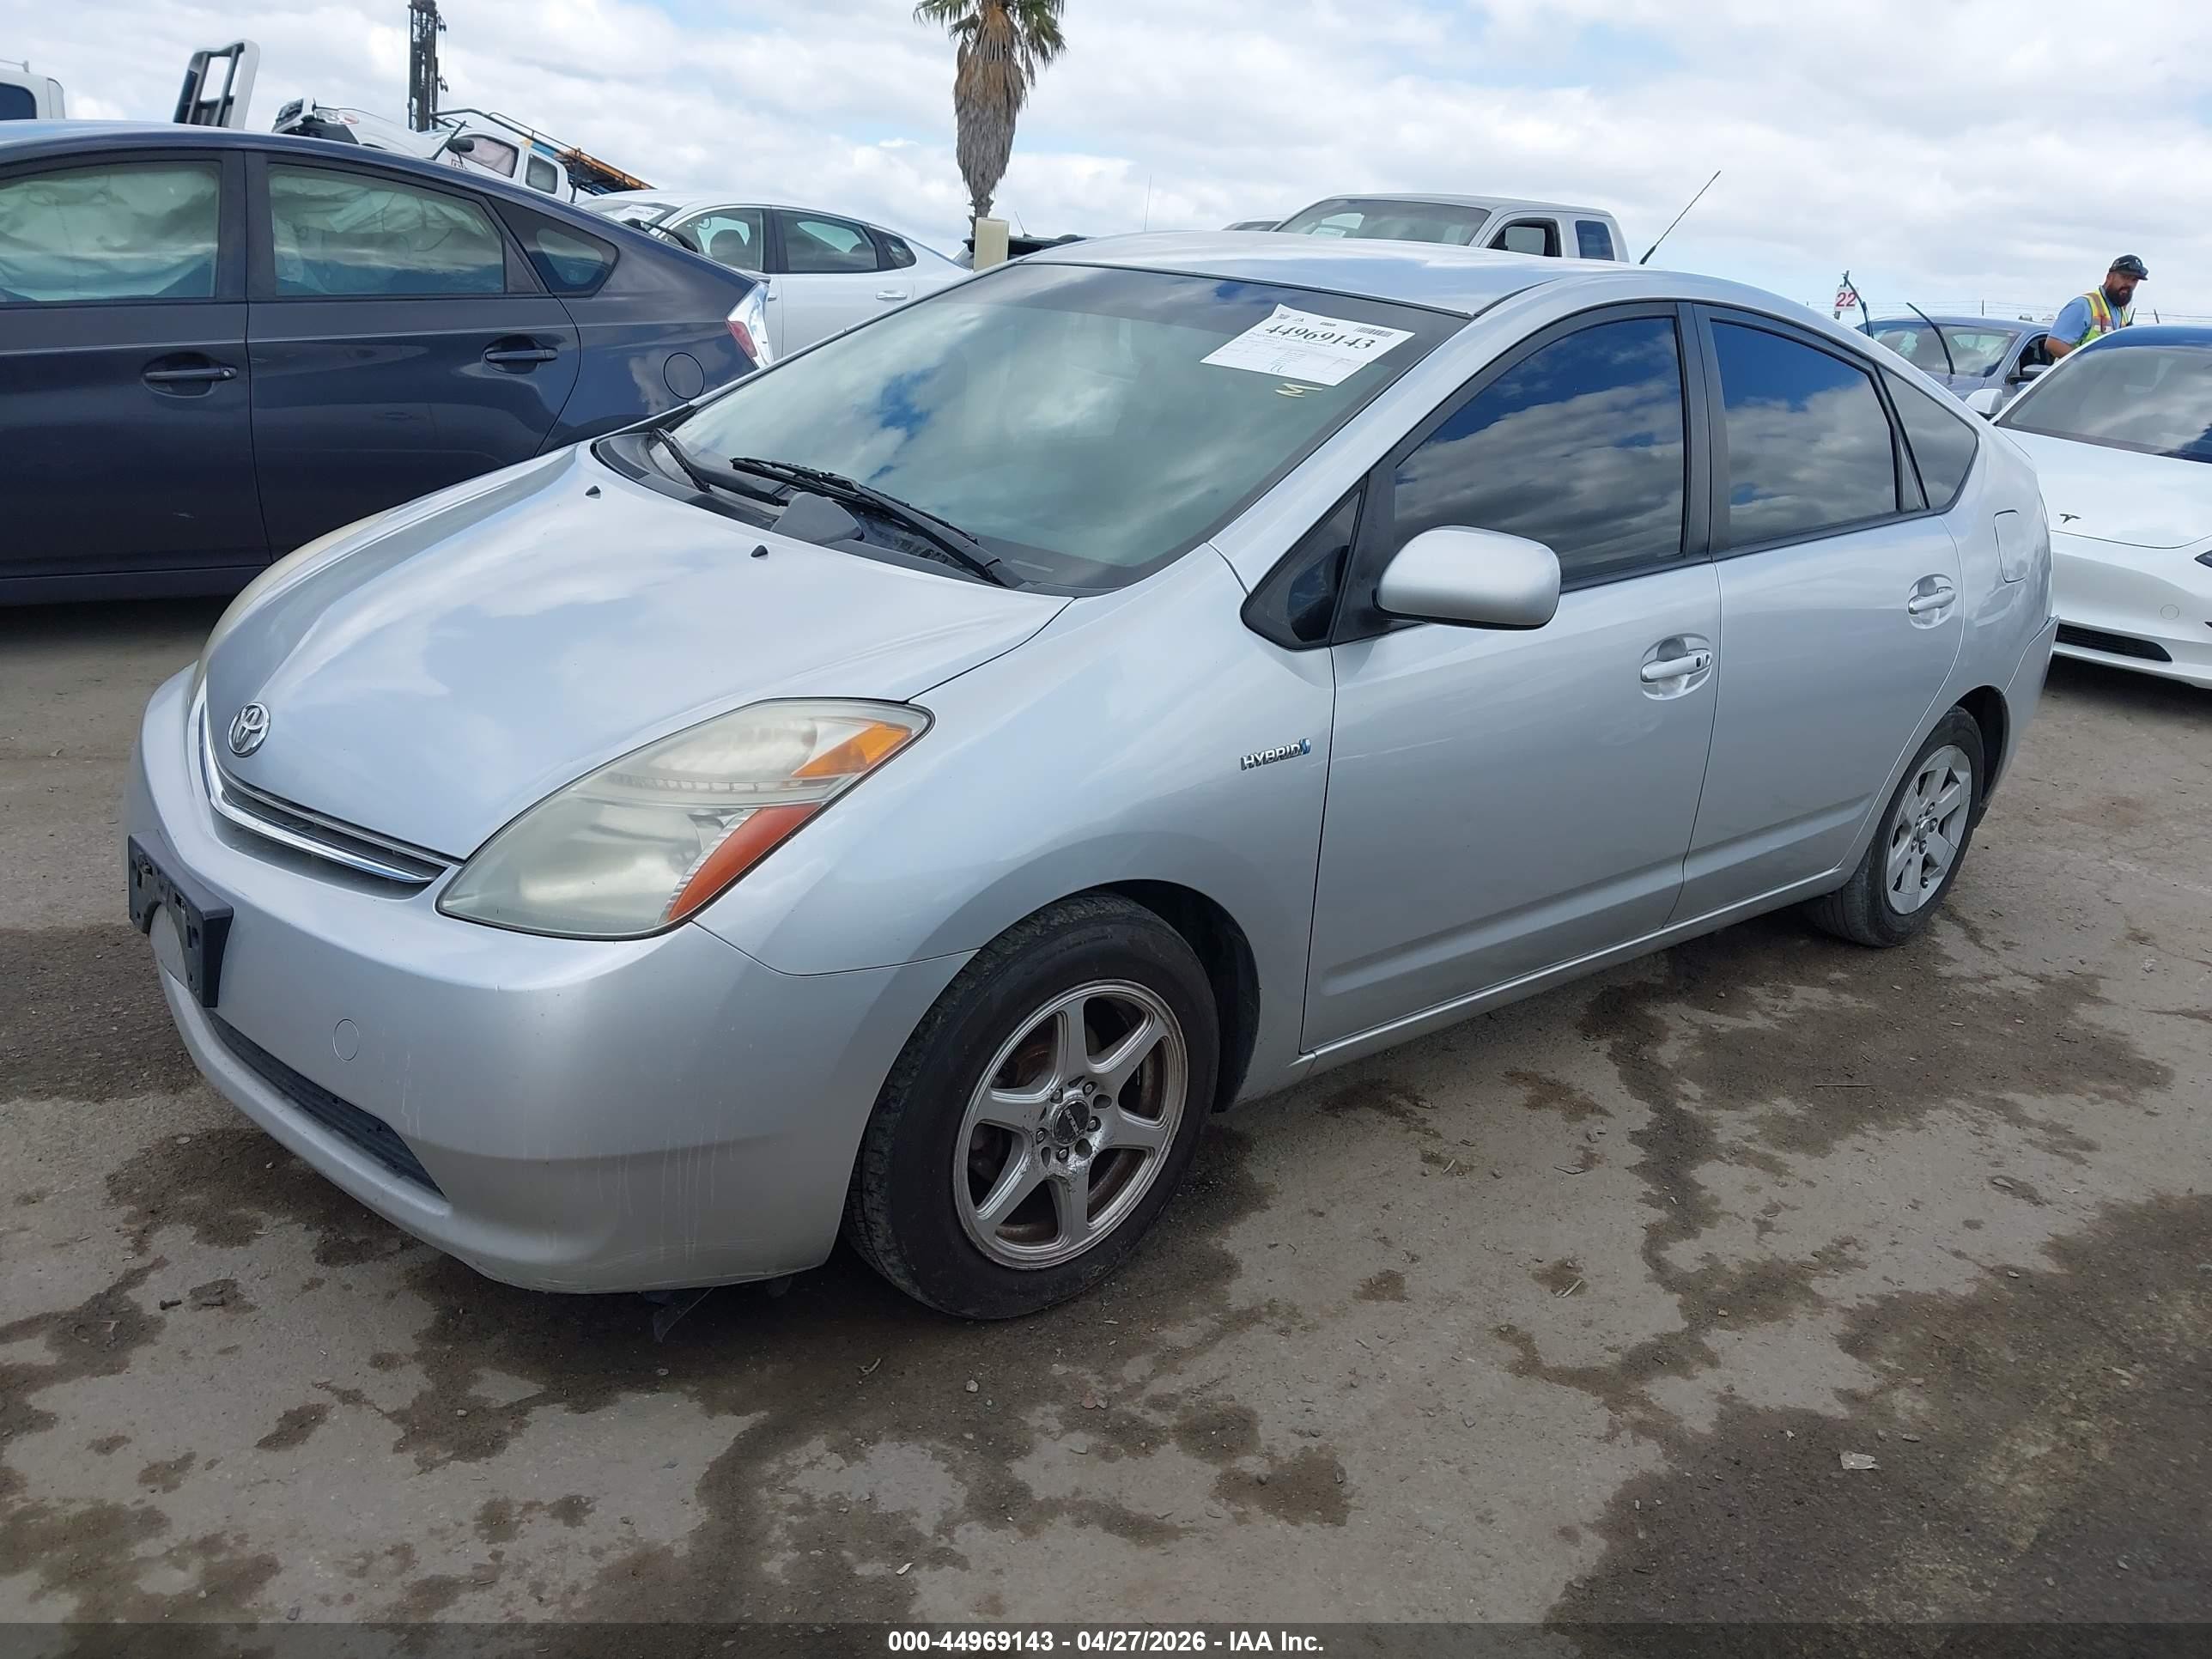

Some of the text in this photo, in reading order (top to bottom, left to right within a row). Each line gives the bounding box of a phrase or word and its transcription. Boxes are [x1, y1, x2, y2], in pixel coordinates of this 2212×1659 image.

[1835, 291, 1857, 307] 22
[1265, 324, 1376, 349] 44969143
[1240, 742, 1302, 771] HYBRID
